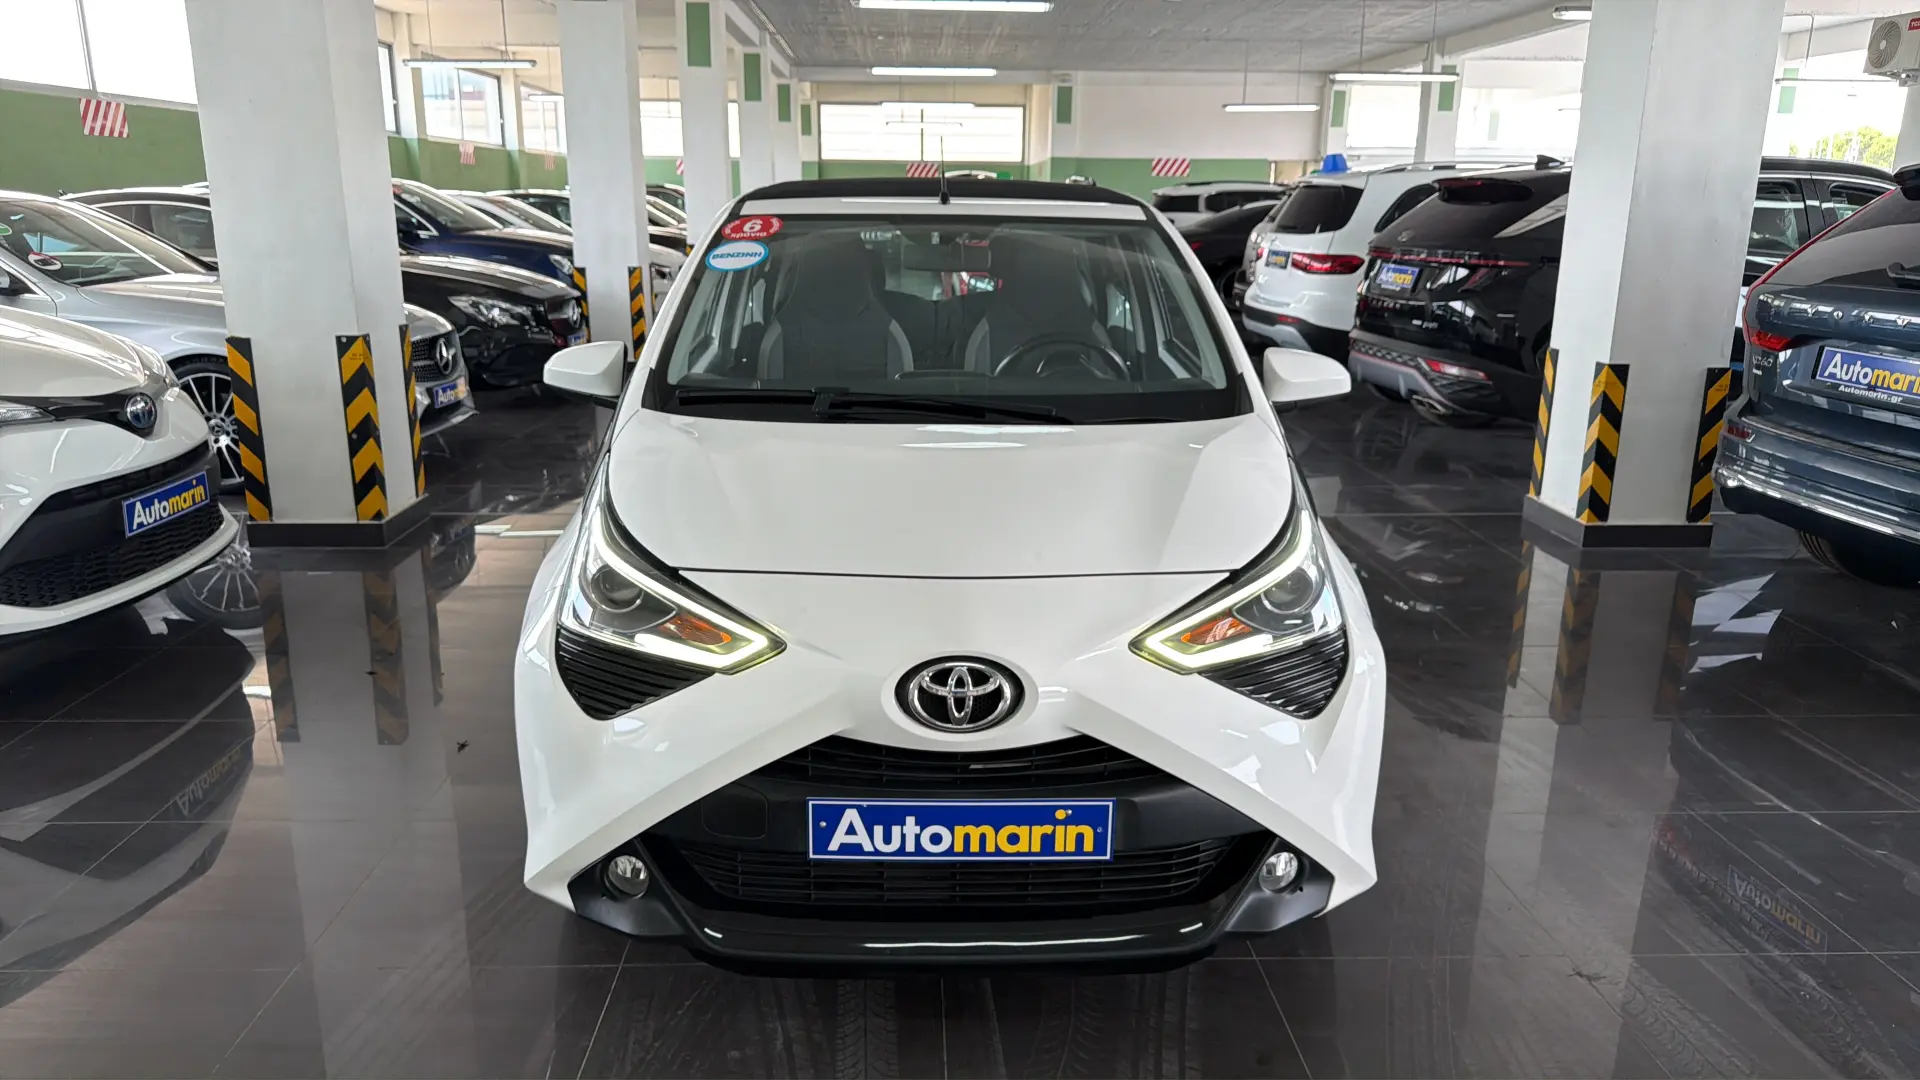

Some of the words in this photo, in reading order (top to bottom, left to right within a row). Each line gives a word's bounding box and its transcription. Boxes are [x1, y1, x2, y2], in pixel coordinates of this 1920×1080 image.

[743, 219, 763, 233] 6
[1838, 384, 1903, 403] Automarin.gr
[133, 479, 206, 530] Automarin
[827, 808, 1094, 852] Automarin
